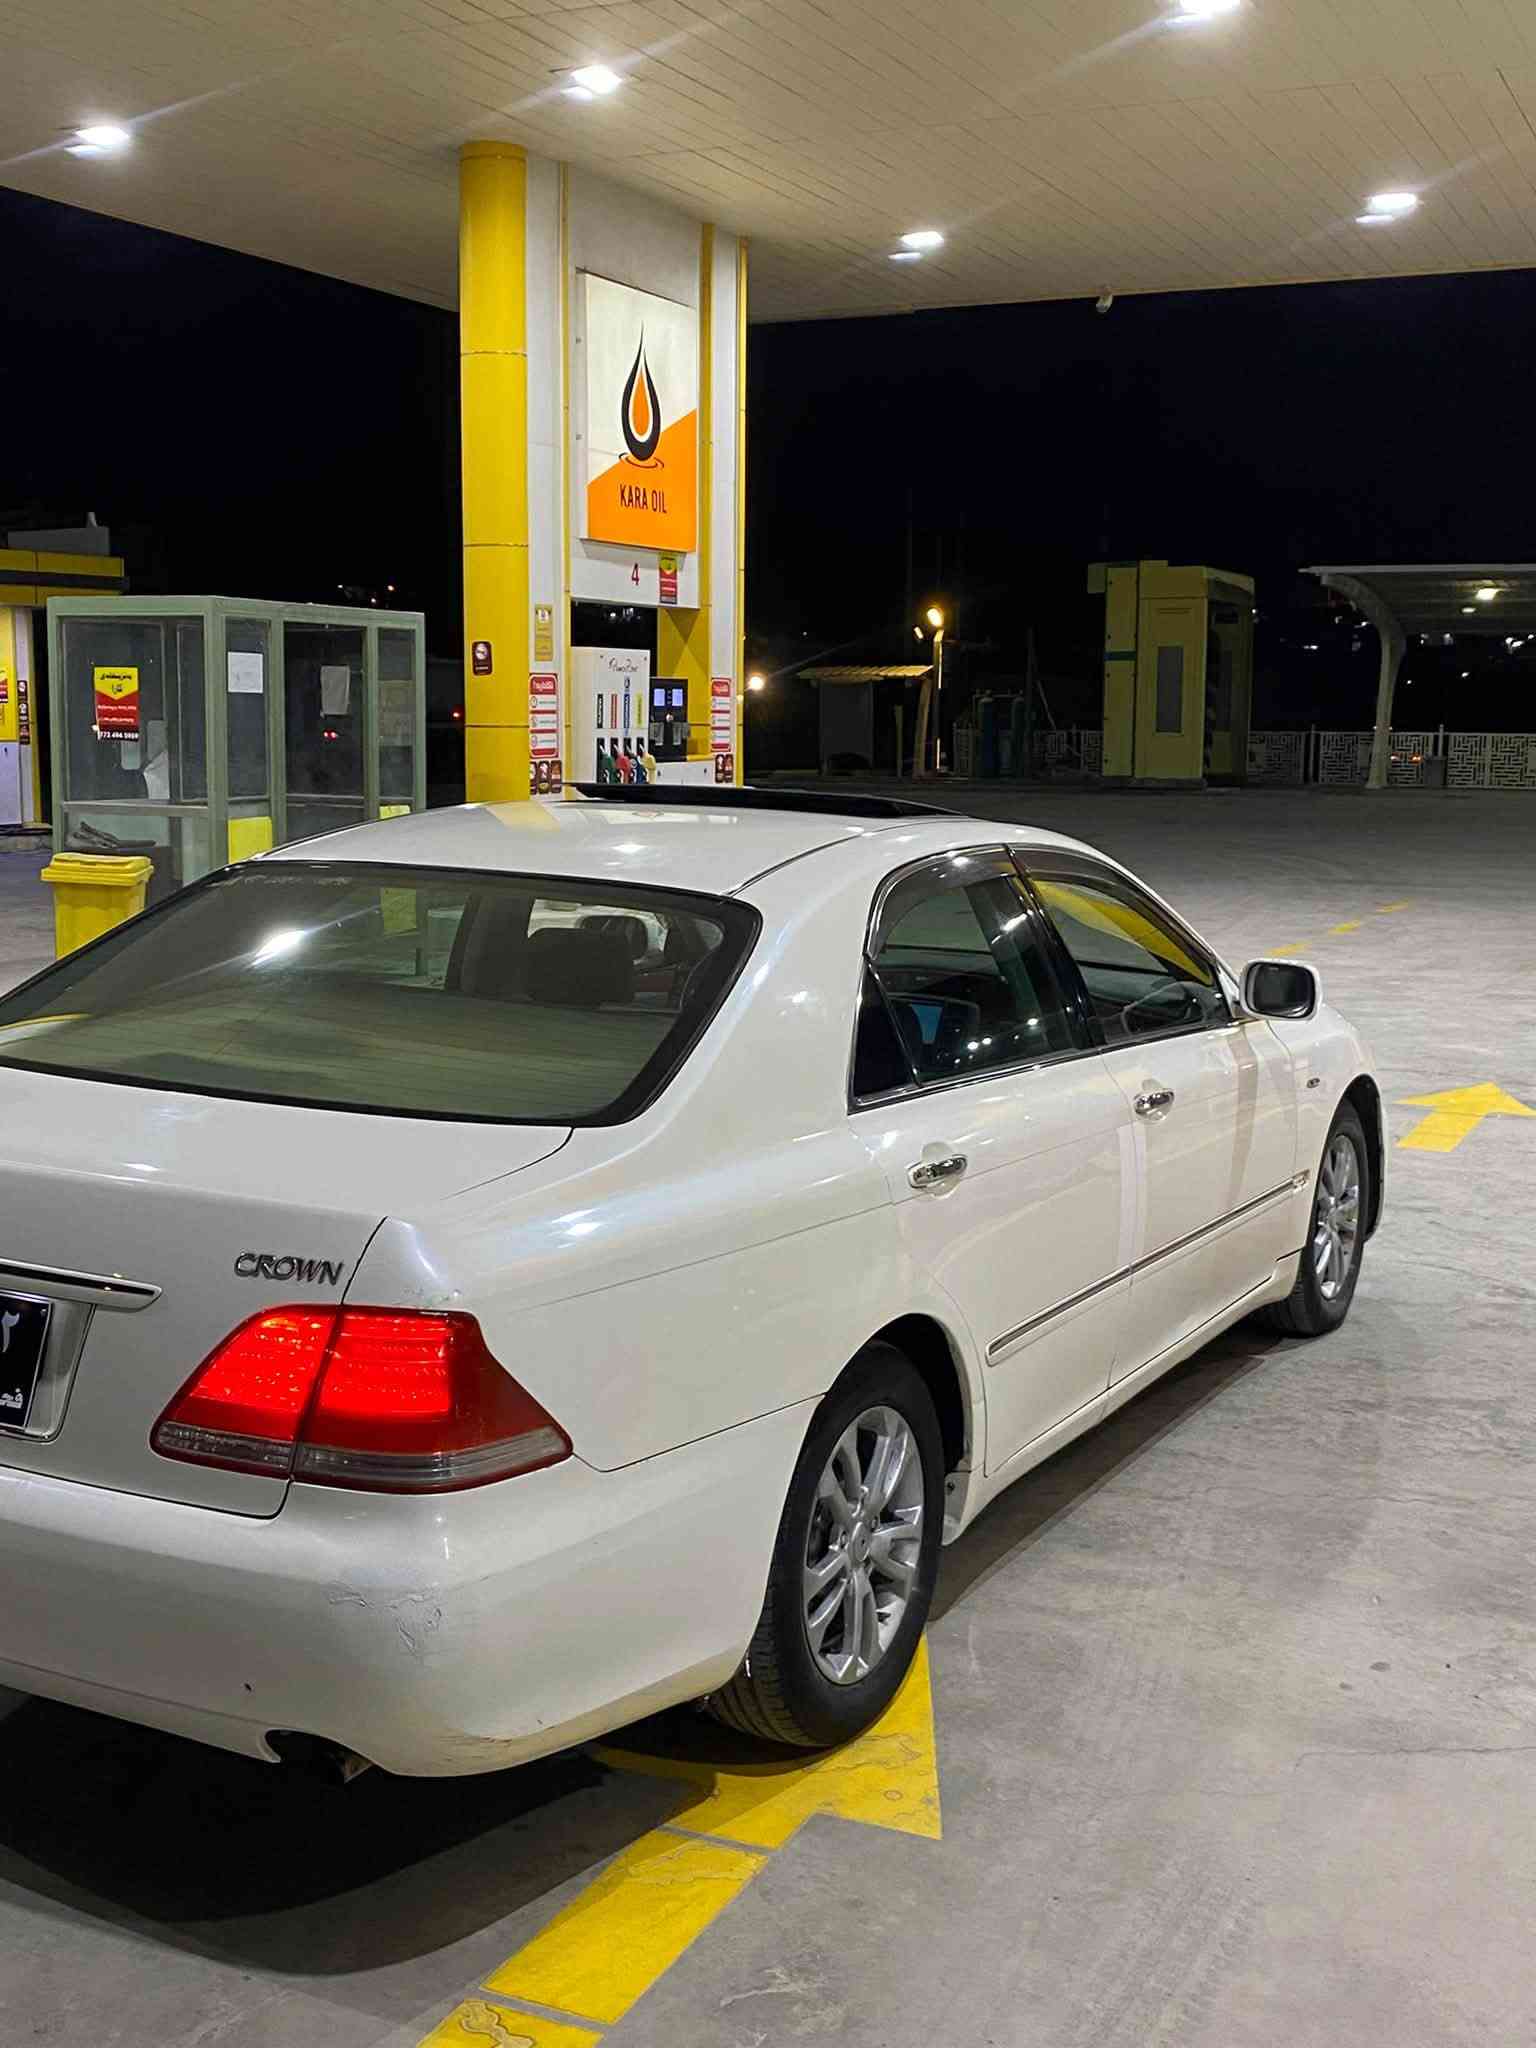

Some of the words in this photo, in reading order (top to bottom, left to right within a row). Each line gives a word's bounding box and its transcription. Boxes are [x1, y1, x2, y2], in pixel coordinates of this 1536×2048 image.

[619, 483, 648, 510] KARA
[651, 489, 668, 514] OIL
[631, 562, 640, 586] 4
[233, 1252, 344, 1286] CROWN
